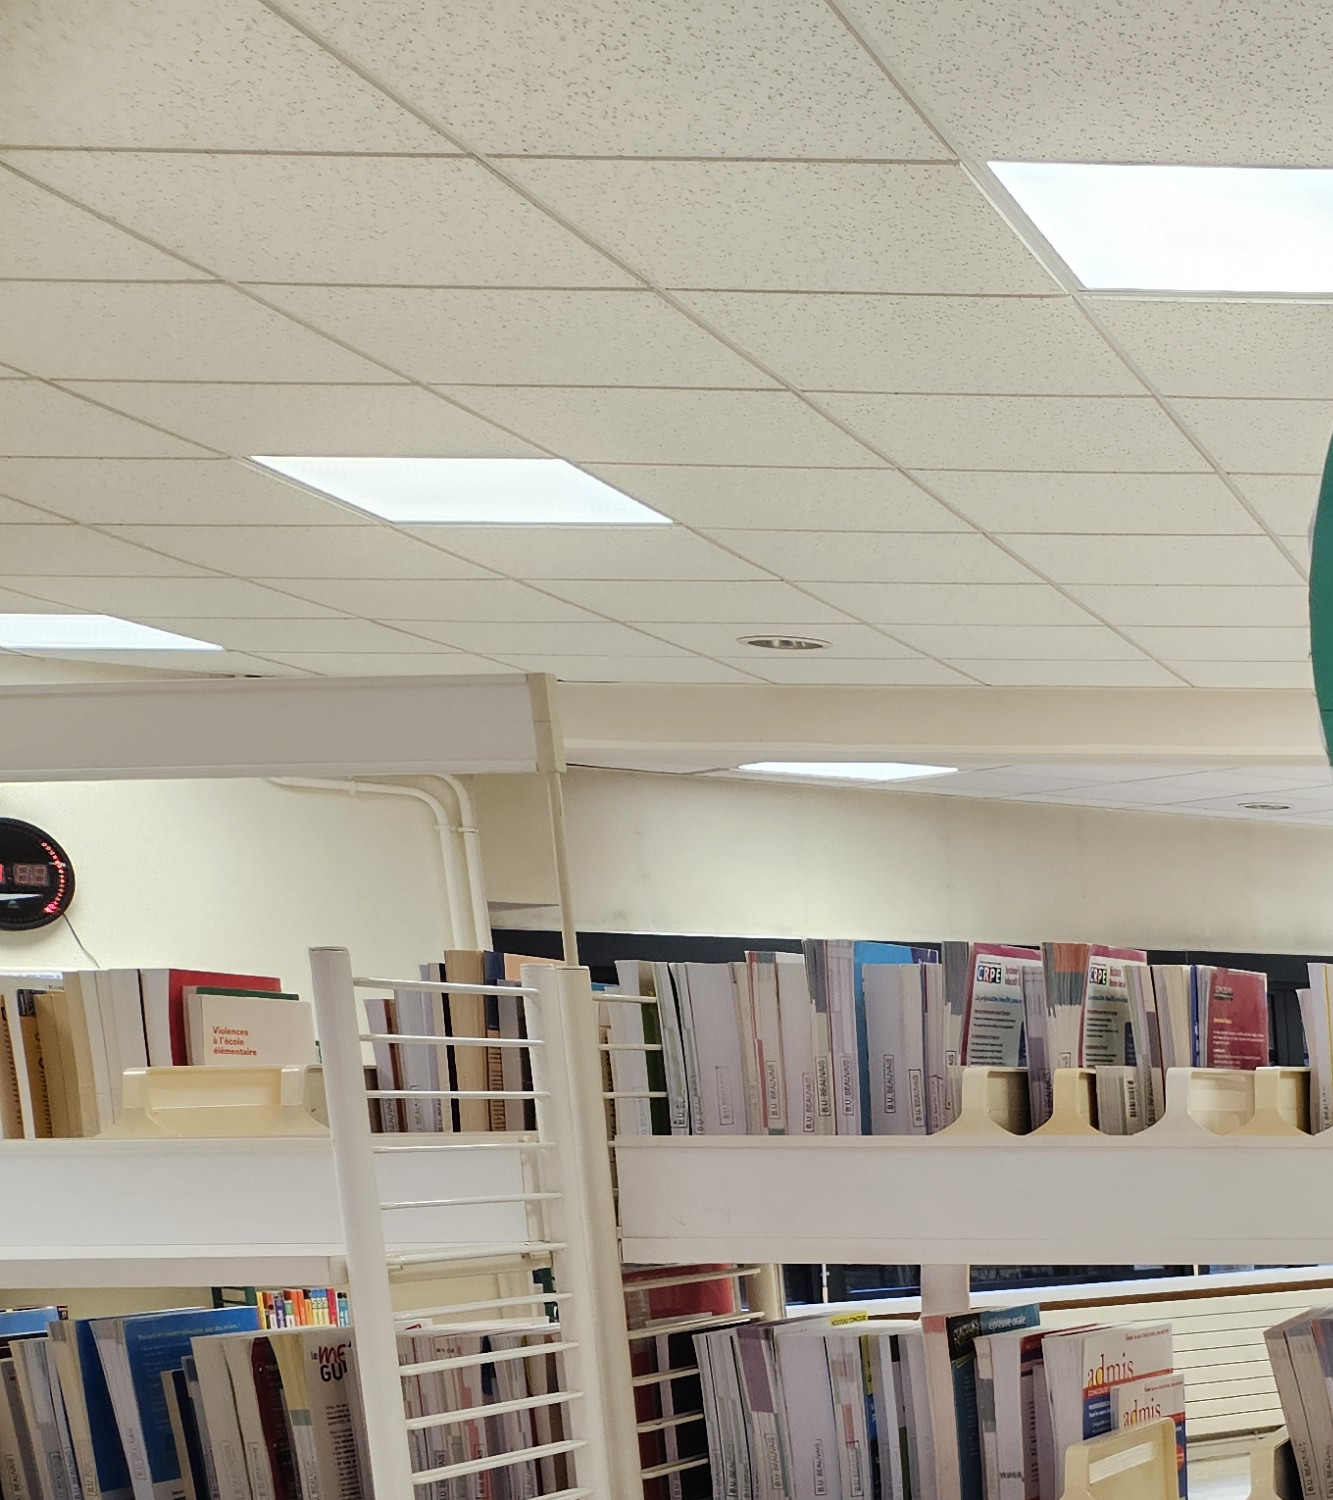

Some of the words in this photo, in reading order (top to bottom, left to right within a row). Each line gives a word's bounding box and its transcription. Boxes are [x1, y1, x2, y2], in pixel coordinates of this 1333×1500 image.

[977, 965, 1001, 983] CRPE
[212, 1027, 249, 1036] Violences
[1087, 1352, 1134, 1388] admis
[1123, 1397, 1161, 1427] admis
